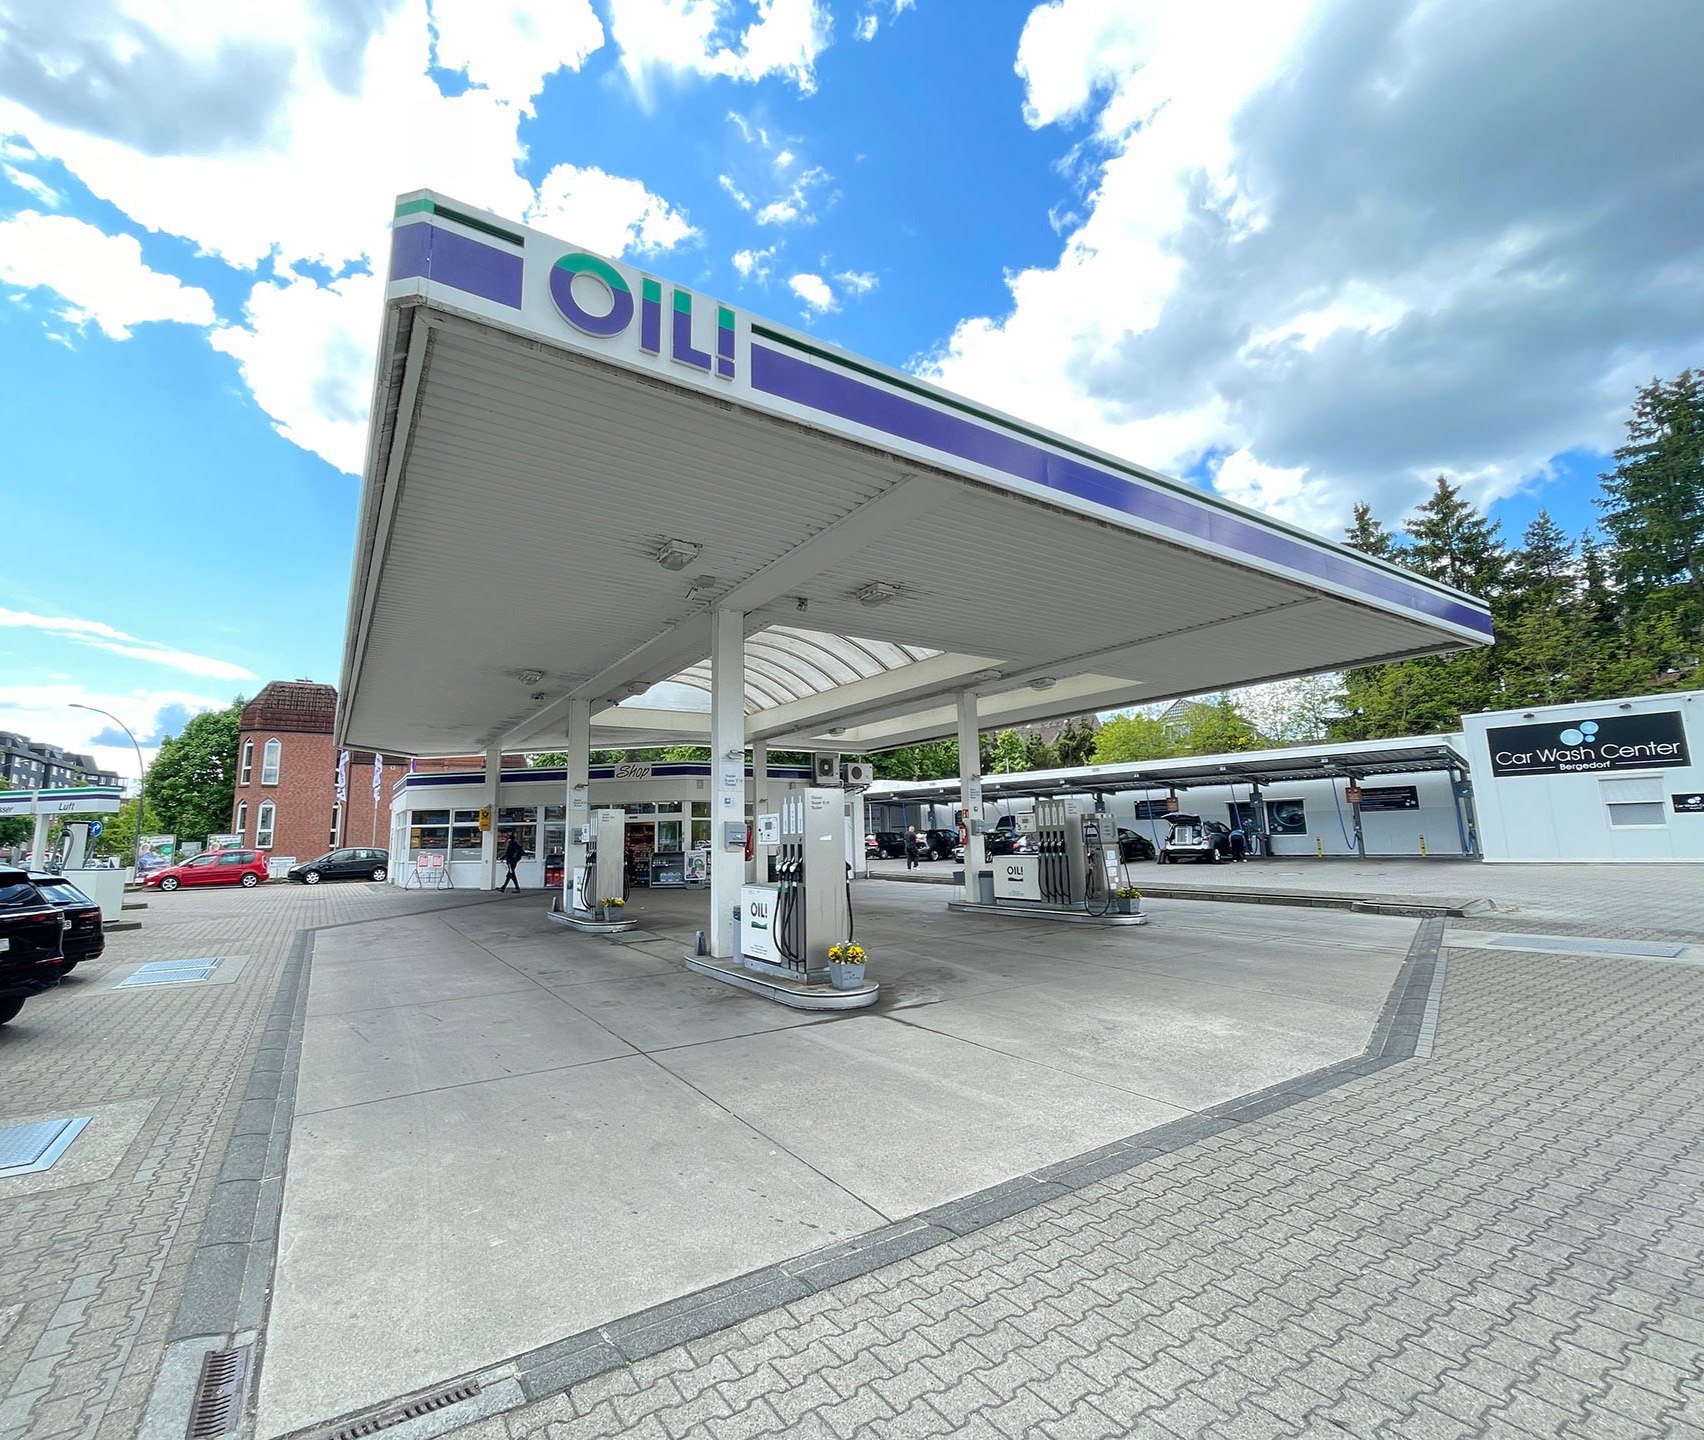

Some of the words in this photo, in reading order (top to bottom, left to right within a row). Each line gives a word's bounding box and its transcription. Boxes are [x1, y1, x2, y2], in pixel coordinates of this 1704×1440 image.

[549, 252, 736, 381] OIL!
[1495, 750, 1533, 766] Car
[1537, 745, 1595, 763] Wash
[1601, 741, 1681, 759] Center
[616, 764, 650, 780] Shop
[1559, 760, 1611, 771] Bergedorf
[59, 802, 75, 811] Luft
[1006, 865, 1023, 876] OIL!
[750, 901, 768, 919] OIL!
